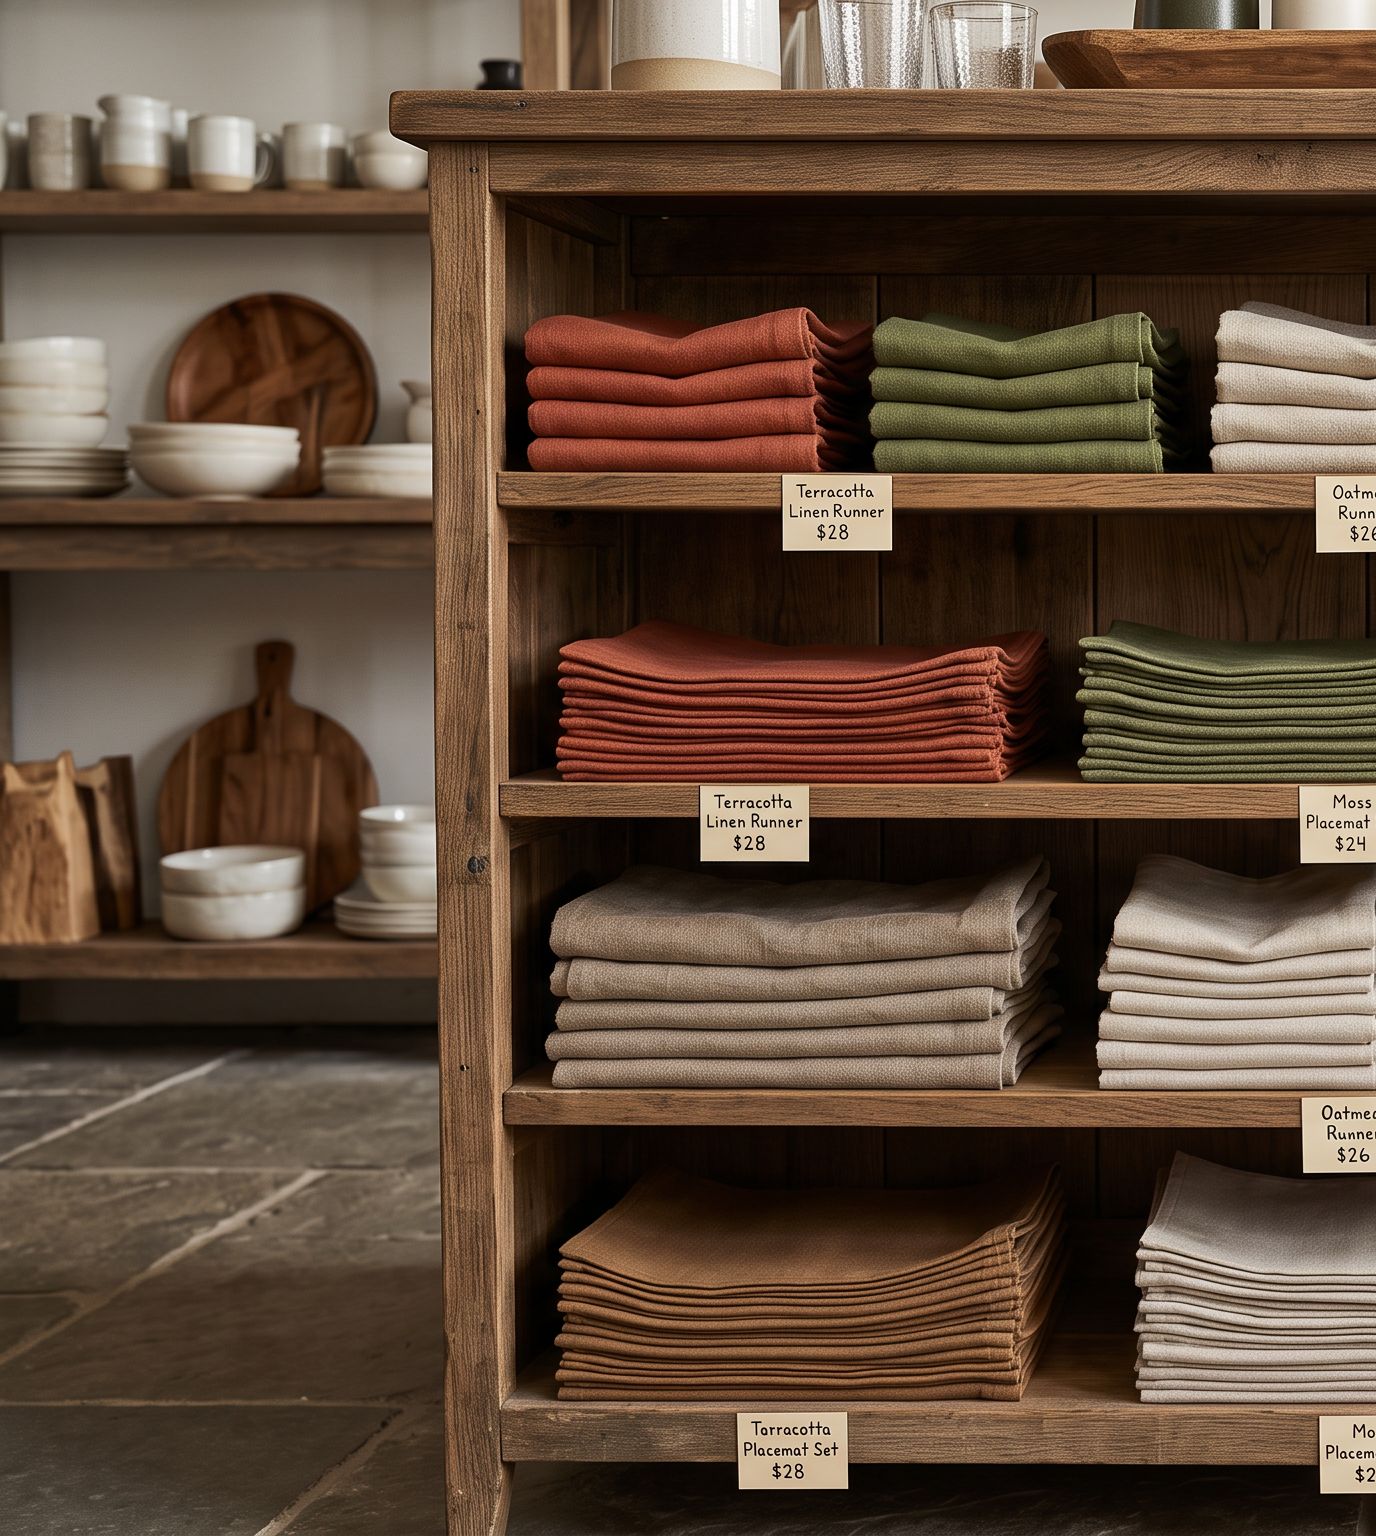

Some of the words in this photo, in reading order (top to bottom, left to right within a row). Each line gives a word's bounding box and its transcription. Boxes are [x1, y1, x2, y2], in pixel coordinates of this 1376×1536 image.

[795, 483, 875, 499] Terracotta
[789, 503, 829, 519] Linen
[833, 503, 885, 519] Runner
[816, 523, 849, 542] $28
[713, 793, 793, 809] Terracotta
[1333, 793, 1372, 809] Moss
[706, 813, 746, 829] Linen
[751, 812, 803, 829] Runner
[1306, 813, 1371, 830] Placemat
[732, 834, 766, 852] $28
[1334, 835, 1366, 853] $24
[1337, 1146, 1370, 1164] $26
[743, 1441, 810, 1457] Placemat
[813, 1441, 839, 1457] Set
[771, 1462, 805, 1480] $28
